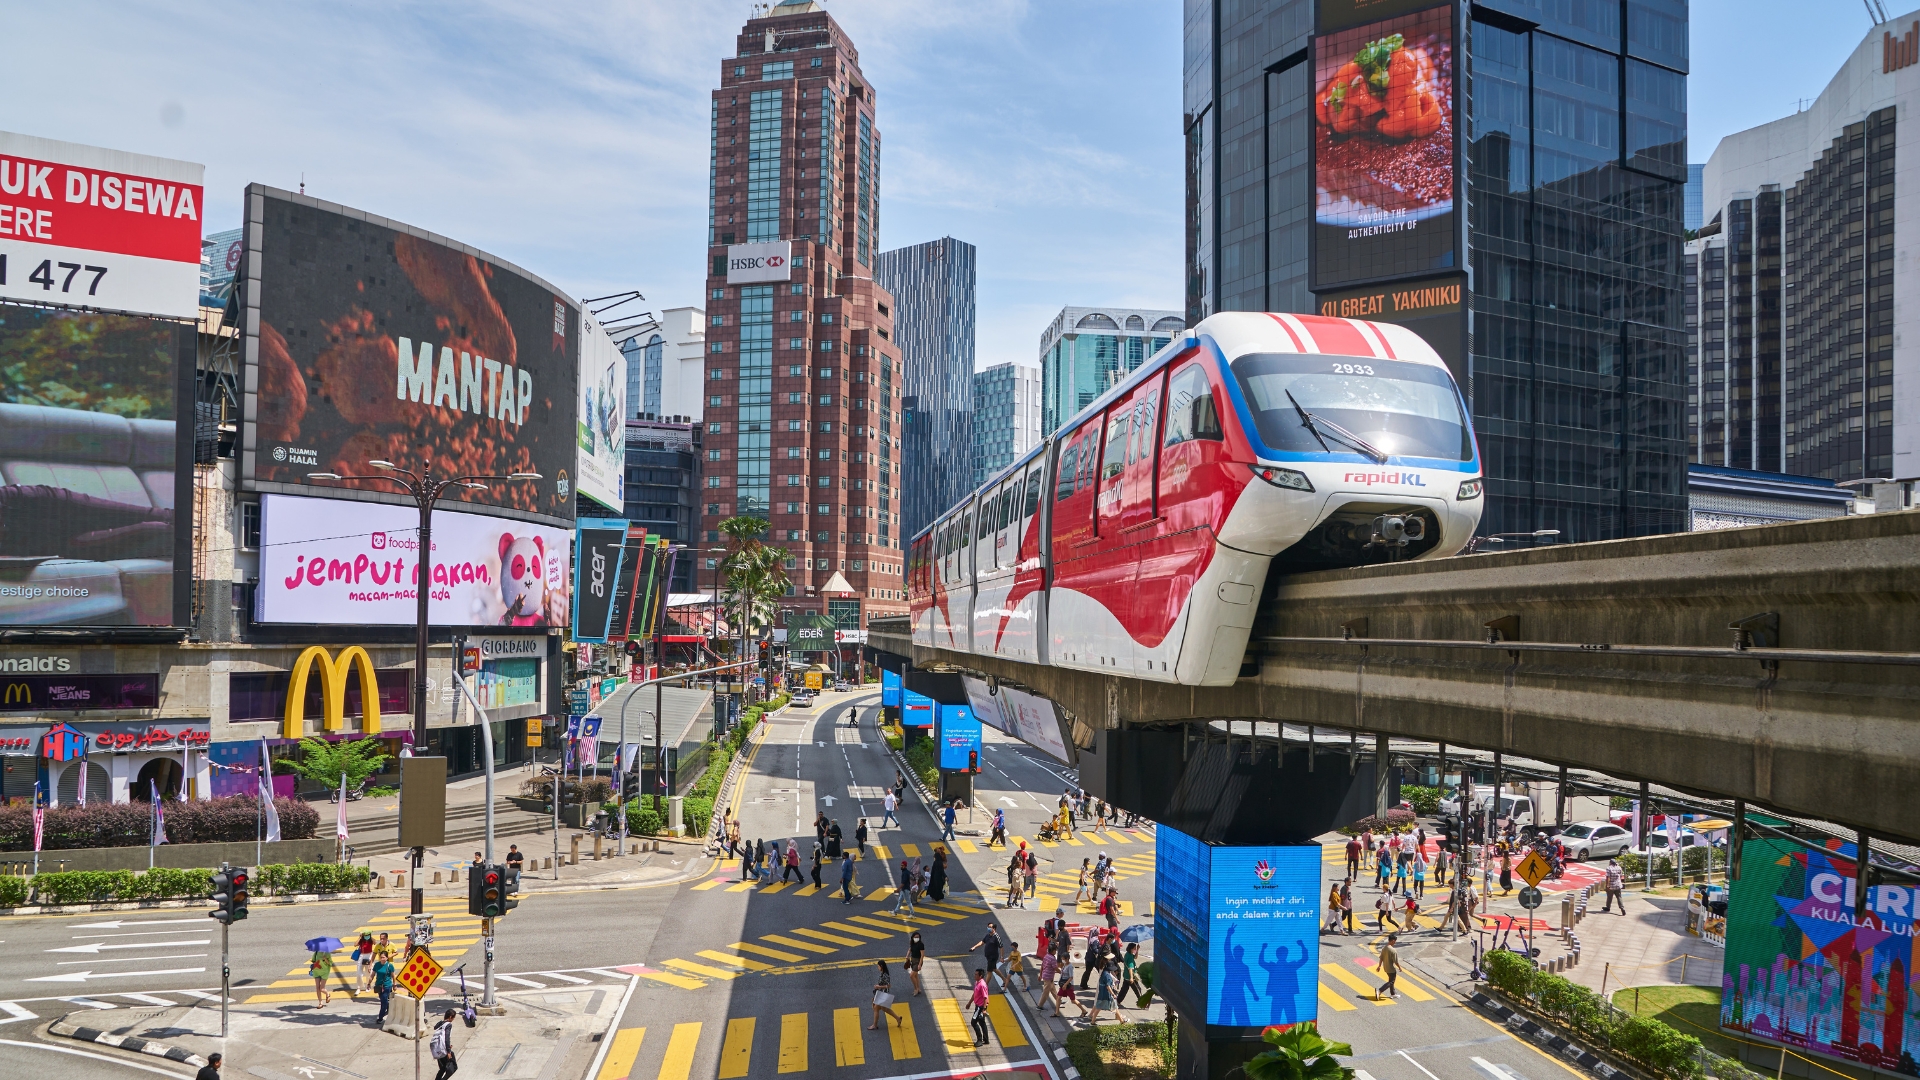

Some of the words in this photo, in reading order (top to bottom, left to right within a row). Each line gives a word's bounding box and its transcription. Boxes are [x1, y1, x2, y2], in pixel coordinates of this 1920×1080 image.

[0, 160, 54, 200] UK
[65, 170, 198, 221] DISEWA
[0, 204, 53, 239] ERE
[1358, 211, 1389, 224] SAVOUR
[1391, 207, 1406, 218] THE
[1348, 221, 1404, 240] AUTHENTICITY
[1407, 219, 1417, 230] OF
[730, 257, 765, 270] HSBC
[28, 259, 108, 296] 477
[1341, 294, 1385, 317] GREAT
[1392, 284, 1461, 311] YAKINIKU
[1332, 363, 1375, 375] 2933
[397, 336, 533, 427] MANTAP
[289, 447, 318, 456] DIJAMIN
[289, 455, 318, 466] HALAL
[1344, 472, 1427, 487] rapidKL
[1097, 479, 1124, 511] rapidKL
[389, 536, 437, 553] foodpaa
[590, 546, 606, 598] acer
[46, 585, 89, 597] choice
[349, 589, 419, 602] macam-mac
[431, 587, 451, 602] ada
[799, 629, 823, 638] EDEN
[481, 639, 537, 656] GIORDANO
[0, 656, 71, 672] nald's
[49, 685, 76, 694] NEW
[52, 690, 91, 700] JEANS
[1225, 896, 1248, 909] Ingin
[1252, 896, 1286, 905] melihat
[1288, 896, 1305, 905] diri
[1216, 910, 1239, 919] anda
[1242, 910, 1270, 919] dalam
[1272, 909, 1295, 919] skrin
[1298, 909, 1314, 918] ini?
[1811, 906, 1875, 931] KUALA
